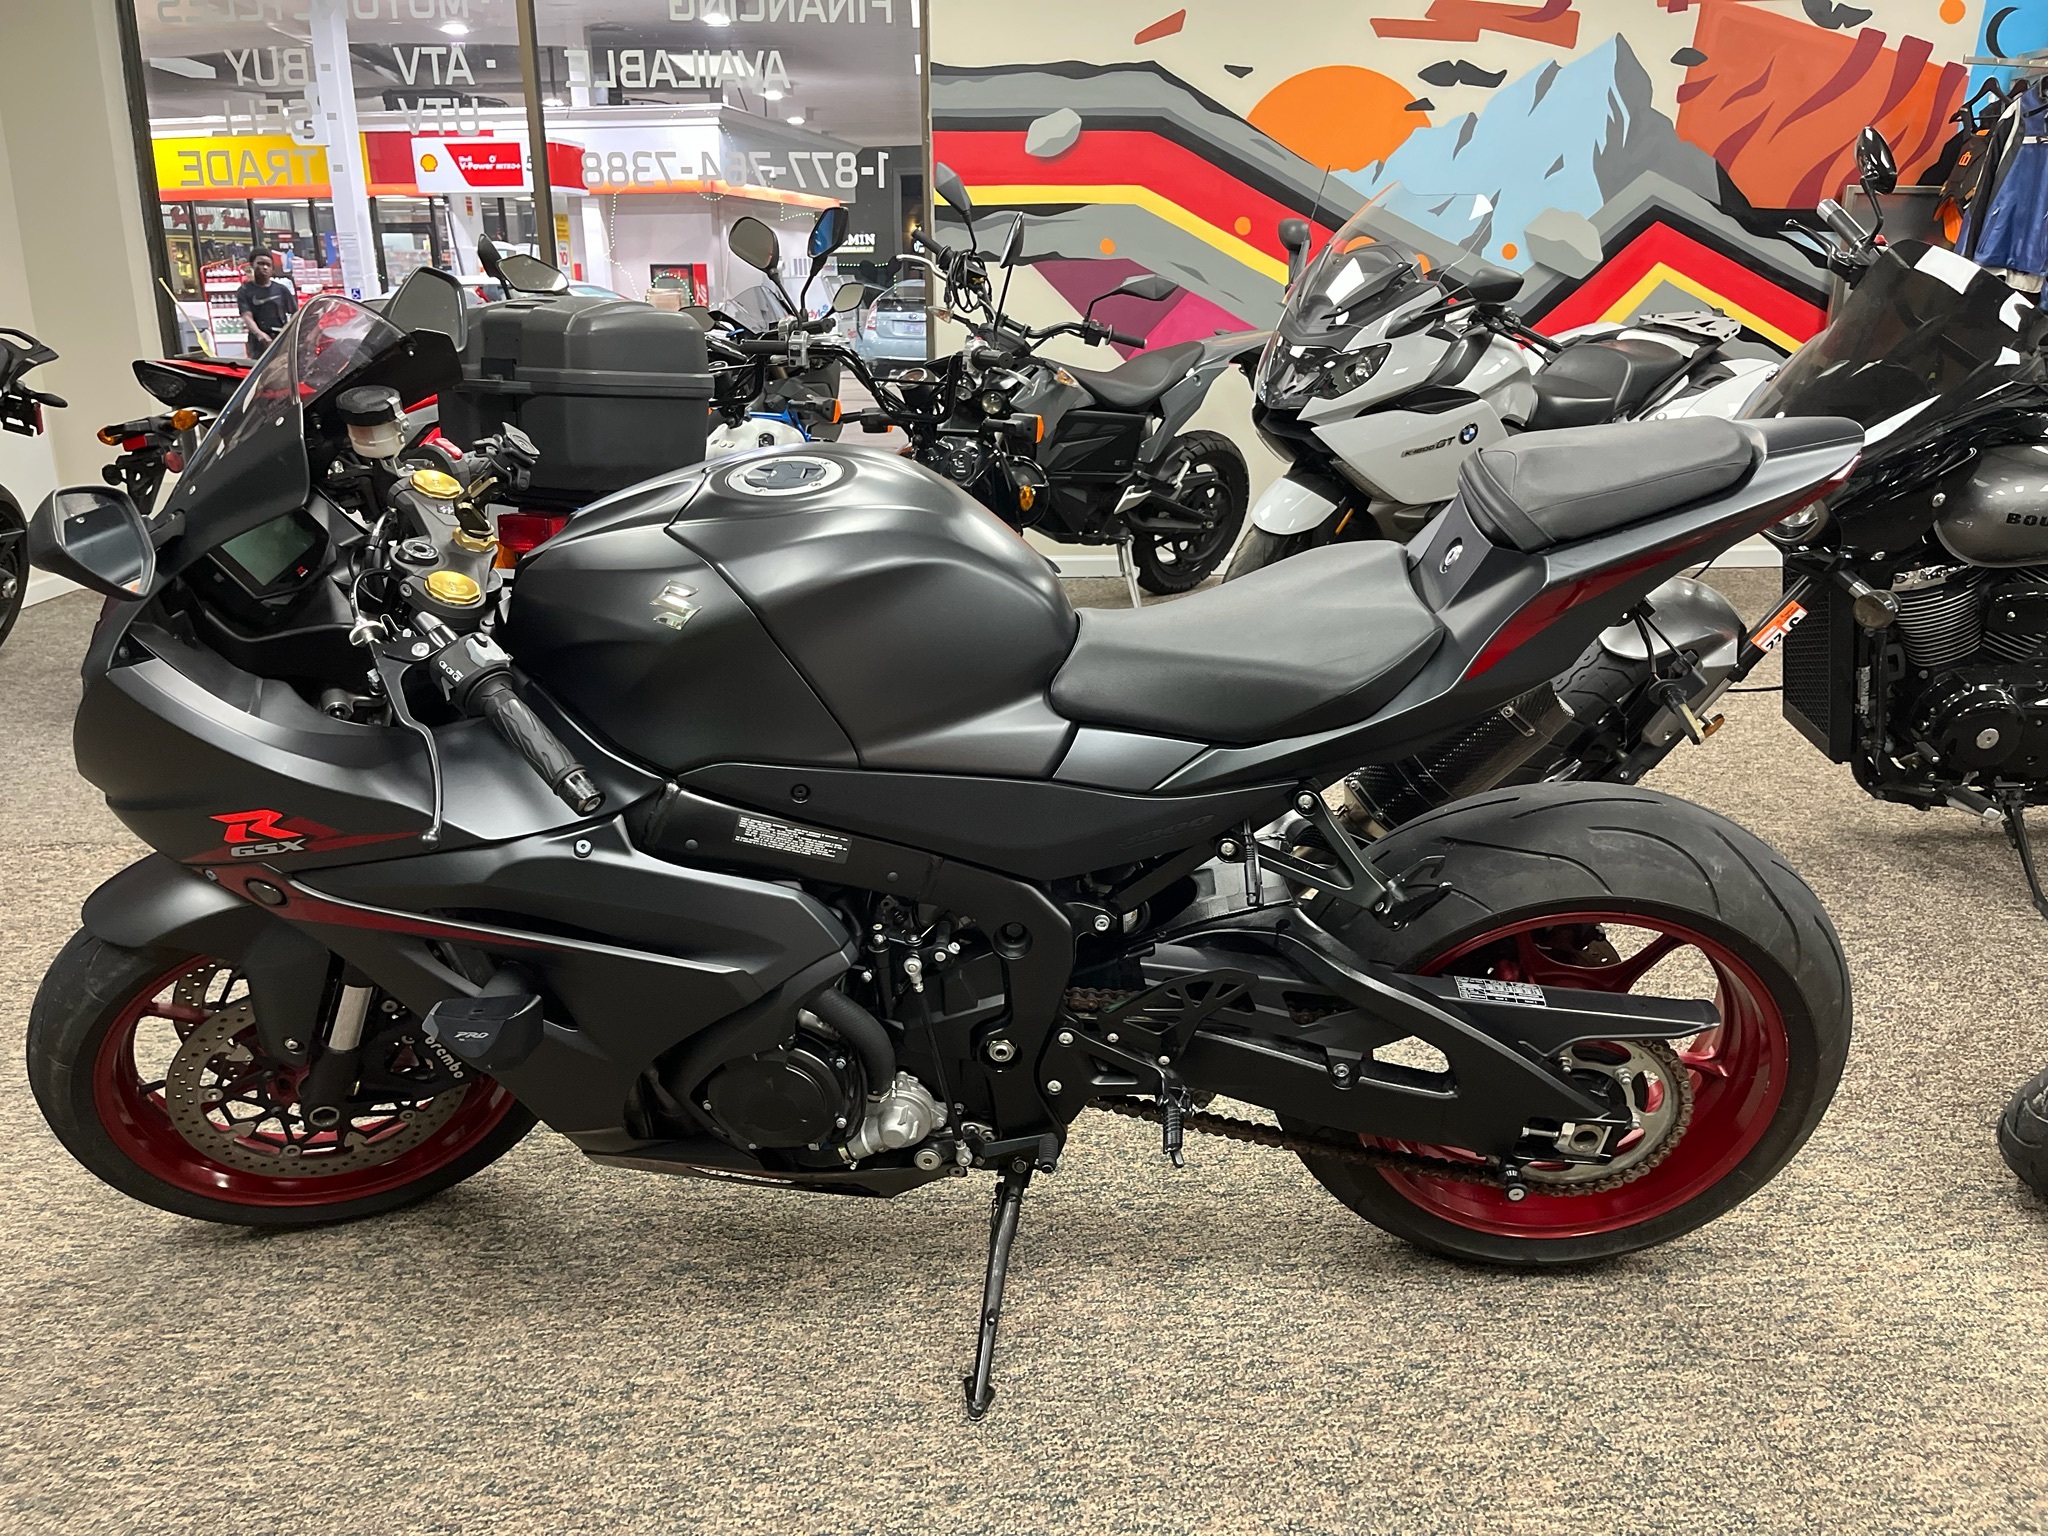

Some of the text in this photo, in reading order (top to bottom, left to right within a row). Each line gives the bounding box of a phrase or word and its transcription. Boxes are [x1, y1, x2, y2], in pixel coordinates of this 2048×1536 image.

[209, 809, 304, 843] R
[231, 839, 307, 857] GSX
[425, 1036, 464, 1079] brembo
